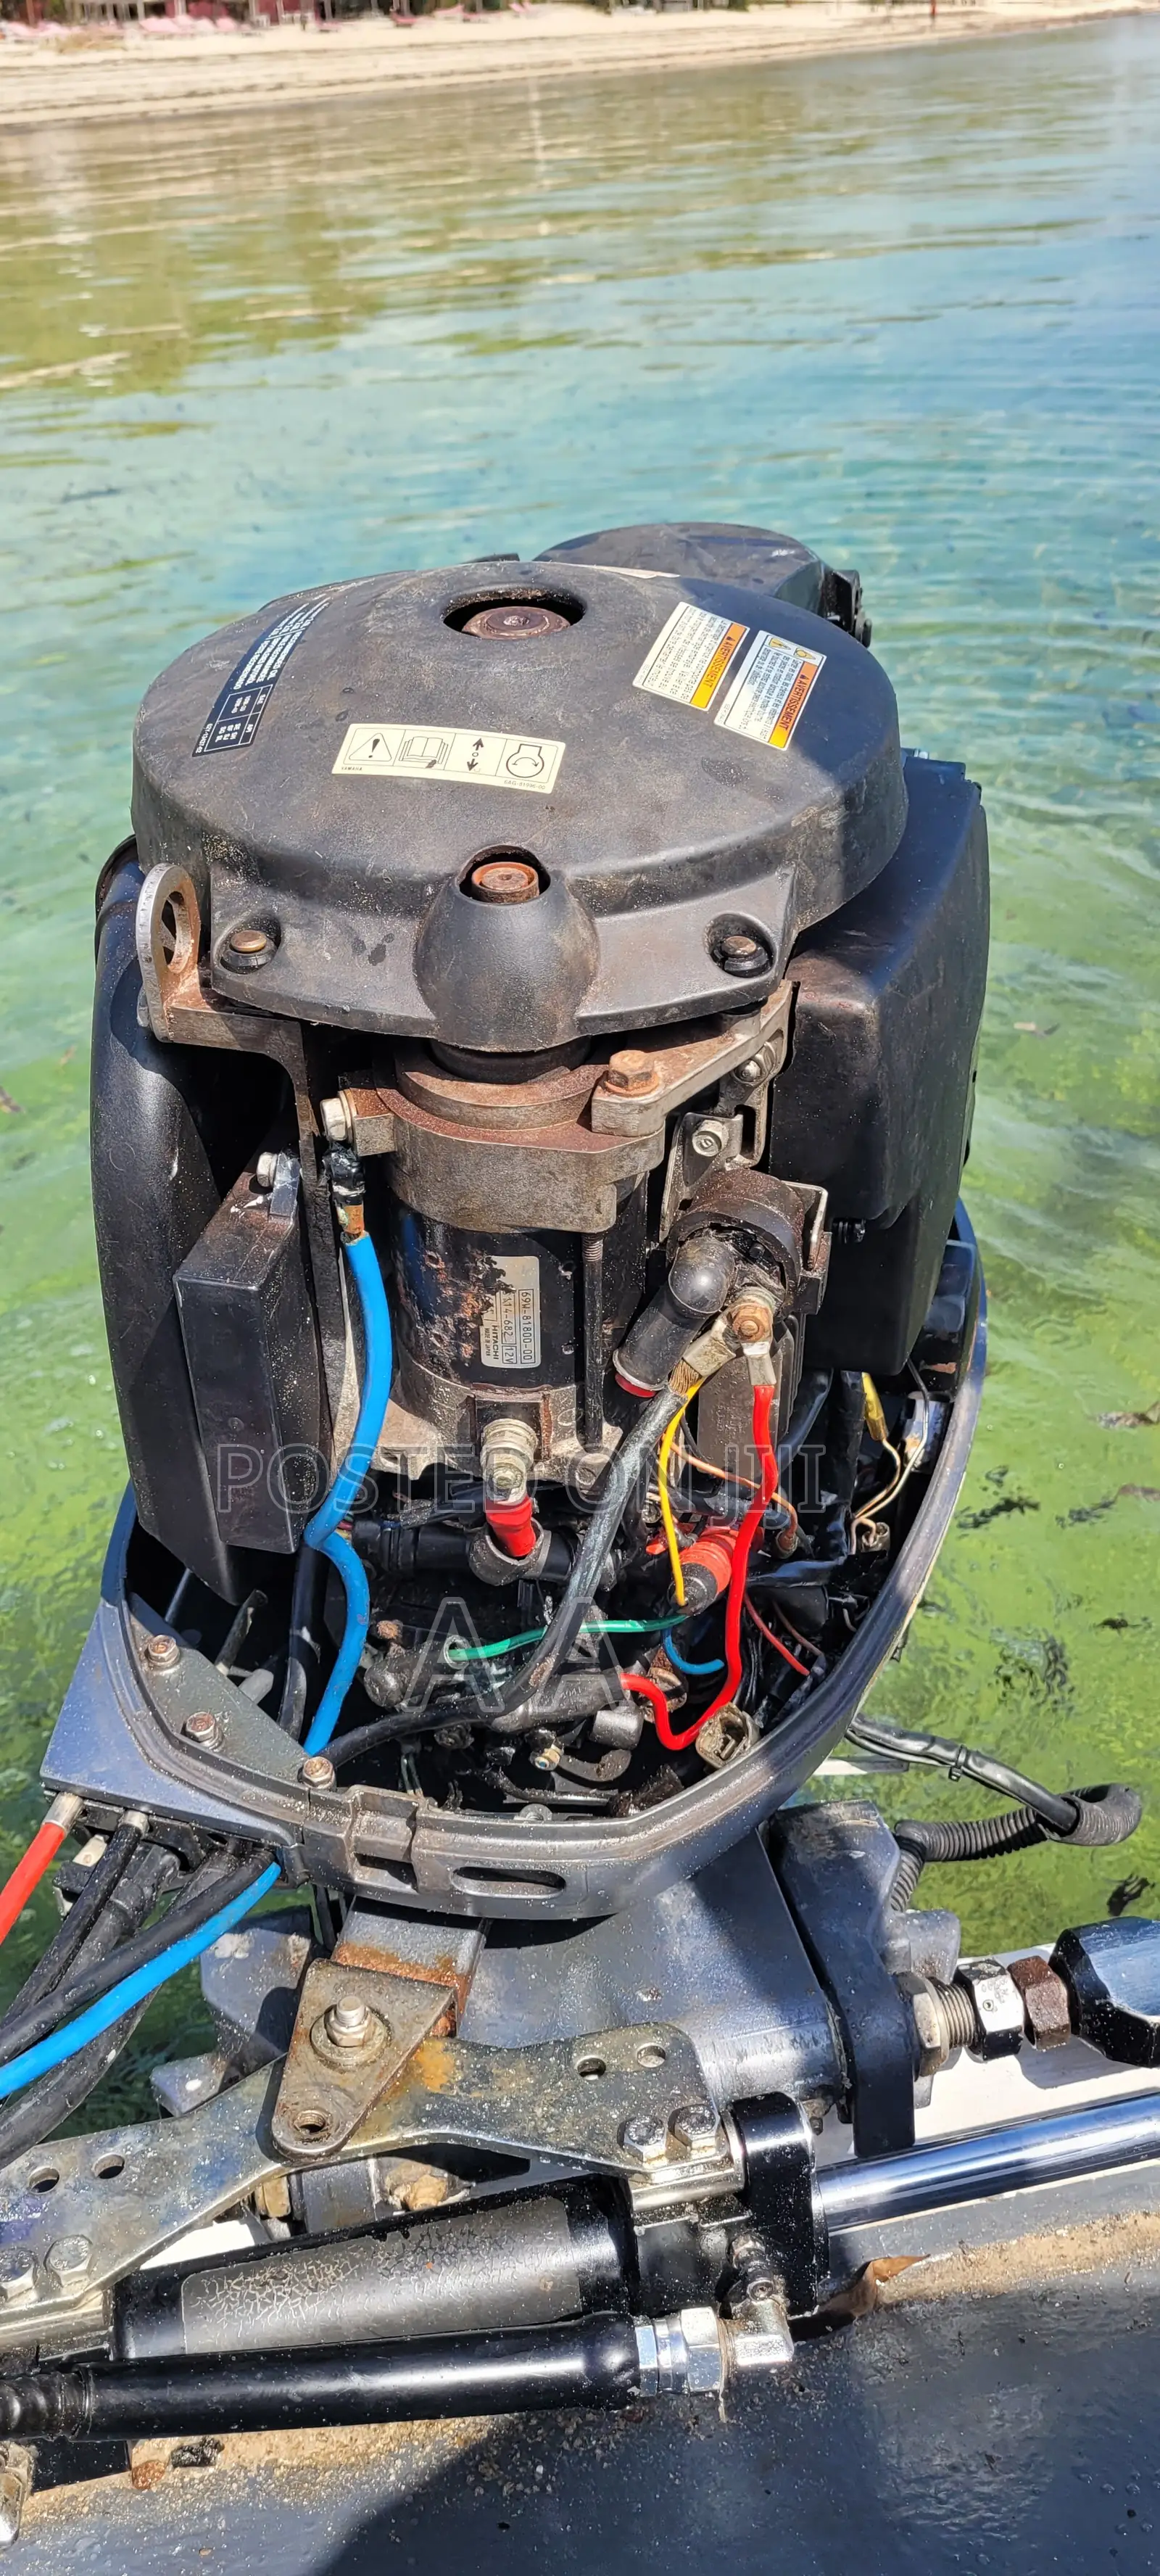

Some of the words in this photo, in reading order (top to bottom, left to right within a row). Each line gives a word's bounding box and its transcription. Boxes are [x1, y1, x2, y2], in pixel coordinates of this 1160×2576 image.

[779, 679, 809, 730] AVERTISSEMENT
[521, 1291, 533, 1361] 69W-81800-00
[504, 1347, 514, 1364] 12V
